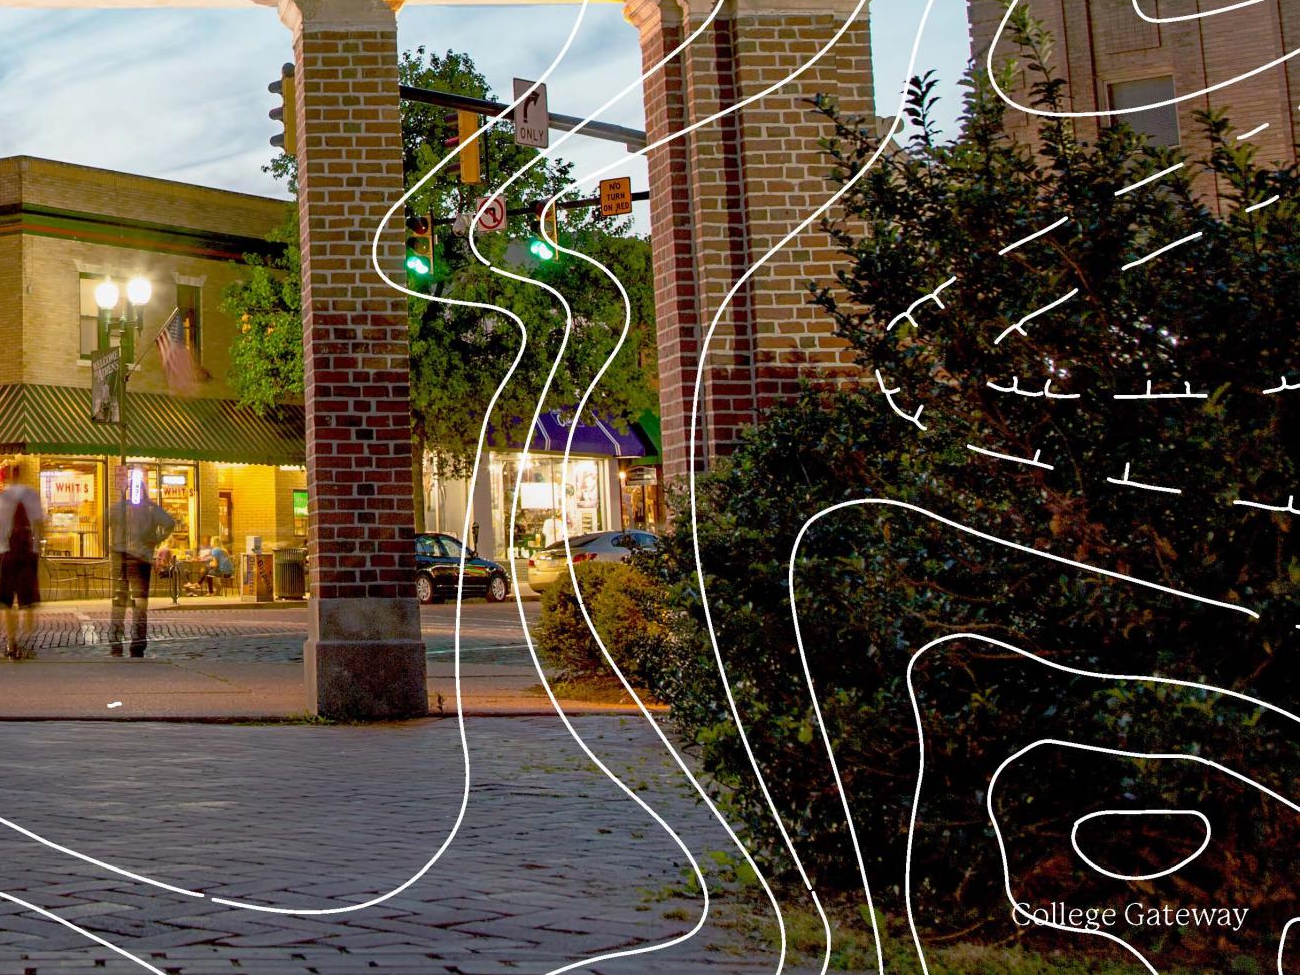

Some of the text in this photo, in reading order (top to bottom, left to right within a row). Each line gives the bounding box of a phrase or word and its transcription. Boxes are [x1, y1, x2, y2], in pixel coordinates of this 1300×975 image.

[520, 127, 544, 141] ONLY
[609, 182, 621, 191] NO
[607, 192, 625, 202] TURN
[603, 201, 630, 212] ON RED
